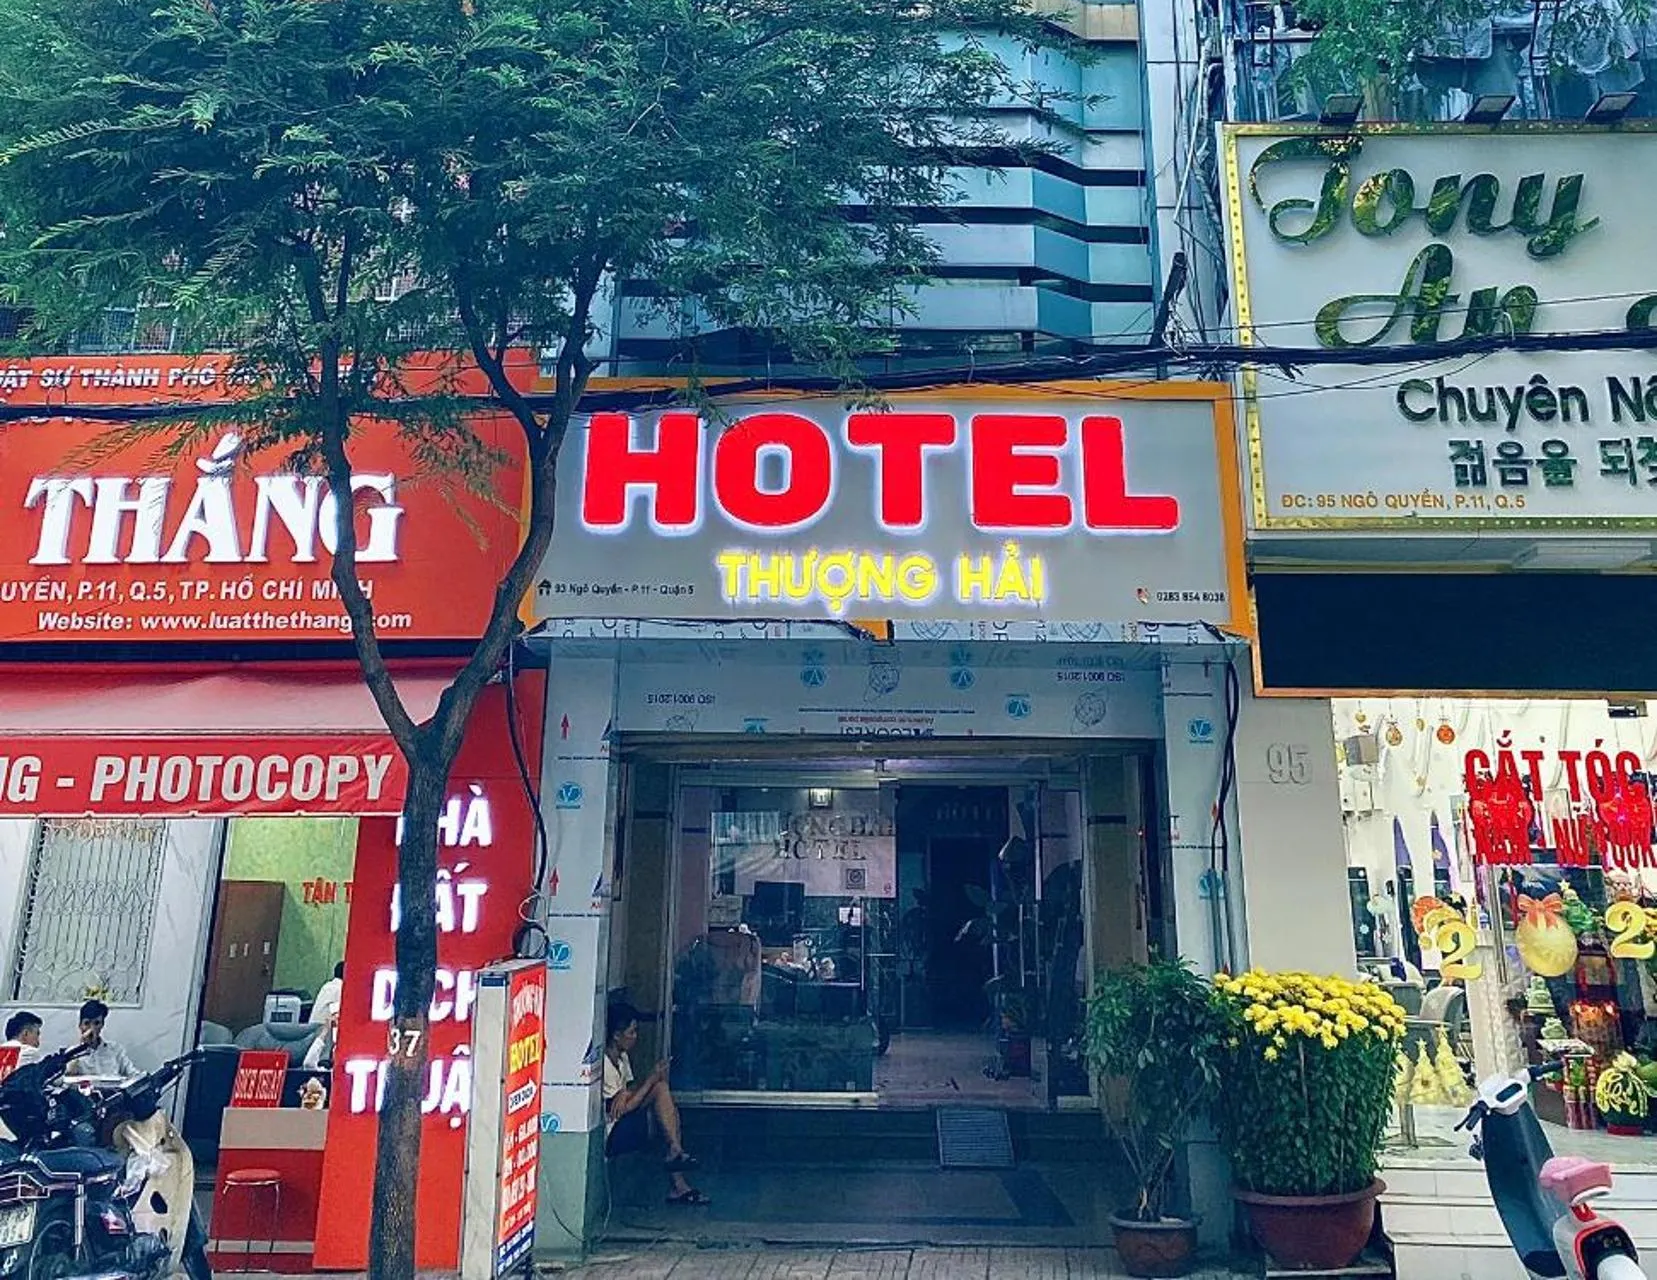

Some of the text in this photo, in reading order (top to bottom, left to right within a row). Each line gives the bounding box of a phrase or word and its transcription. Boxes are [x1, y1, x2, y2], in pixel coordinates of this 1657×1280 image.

[80, 362, 160, 389] THÀNH
[1397, 374, 1590, 431] Chuyên
[582, 413, 1181, 529] HOTEL
[1448, 438, 1578, 487] 젊음을
[22, 433, 404, 565] THẮNG
[1316, 494, 1336, 508] 95
[1341, 489, 1379, 508] NGÔ
[1494, 494, 1526, 510] Q.5
[179, 581, 216, 601] TP.
[262, 576, 304, 601] CHÍ
[312, 579, 373, 601] MIH
[718, 539, 1046, 613] THƯỢNG HẢI
[38, 612, 133, 630] Website:
[89, 753, 394, 803] PHOTOCOPY
[1266, 742, 1313, 785] 95
[1465, 730, 1643, 805] CẮT TÓC
[395, 783, 493, 847] HÀ
[390, 861, 488, 933] ẤT
[371, 968, 478, 1022] DCH
[388, 1027, 421, 1058] 37
